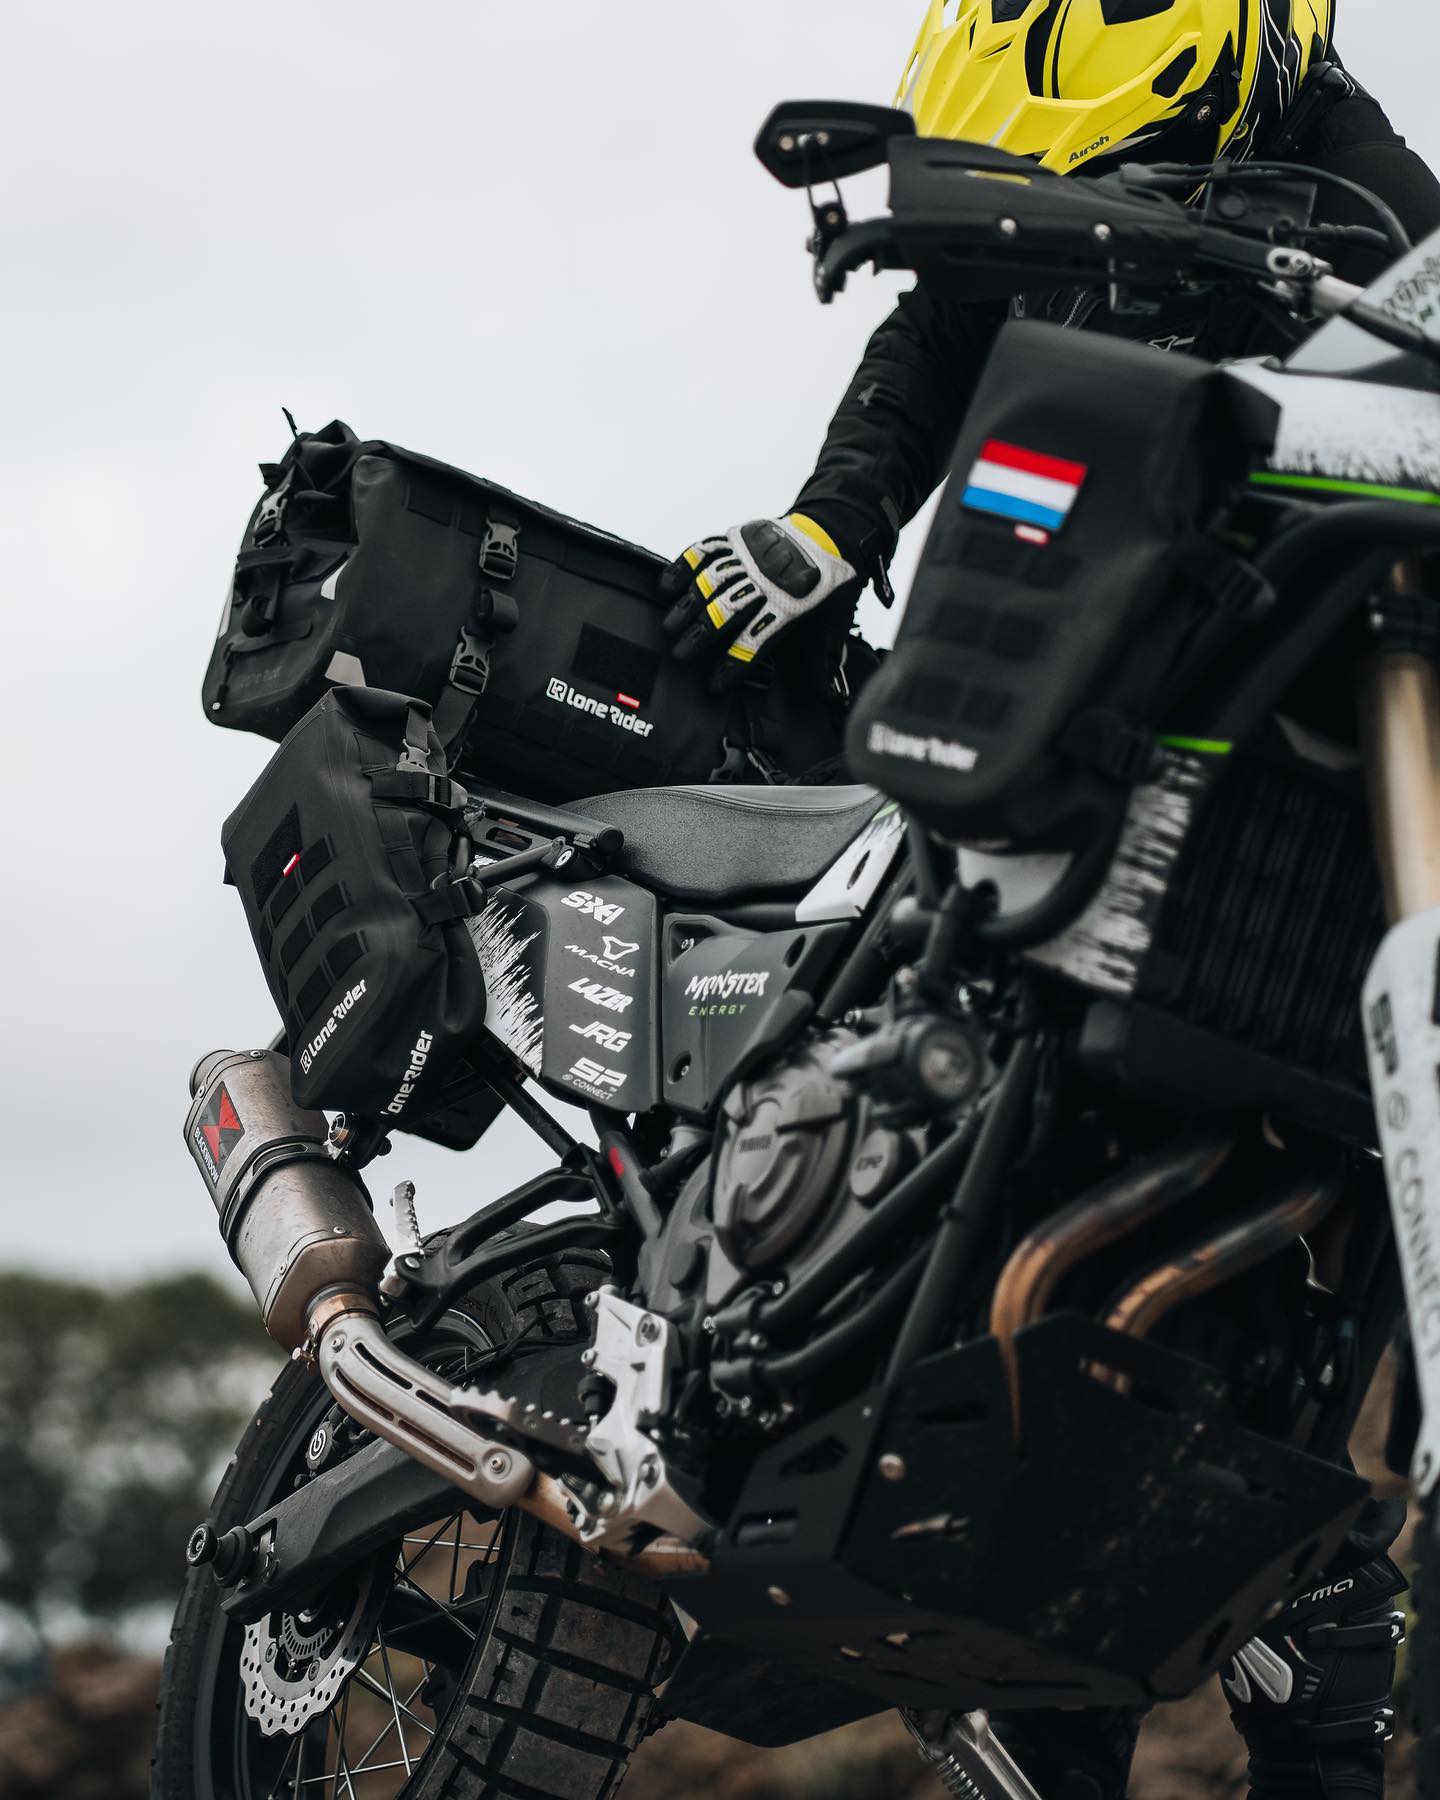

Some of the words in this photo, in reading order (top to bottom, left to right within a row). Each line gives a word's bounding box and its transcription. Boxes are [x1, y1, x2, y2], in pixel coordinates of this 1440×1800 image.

[1068, 135, 1110, 163] Airoh
[563, 945, 636, 977] MACNA
[568, 977, 634, 1013] LAZER
[684, 969, 770, 1002] MONSTER
[688, 1003, 747, 1016] ENERGY
[568, 1021, 633, 1053] JRG
[568, 1057, 628, 1090] SP
[573, 1079, 614, 1100] CONNECT
[1291, 1578, 1354, 1608] rma
